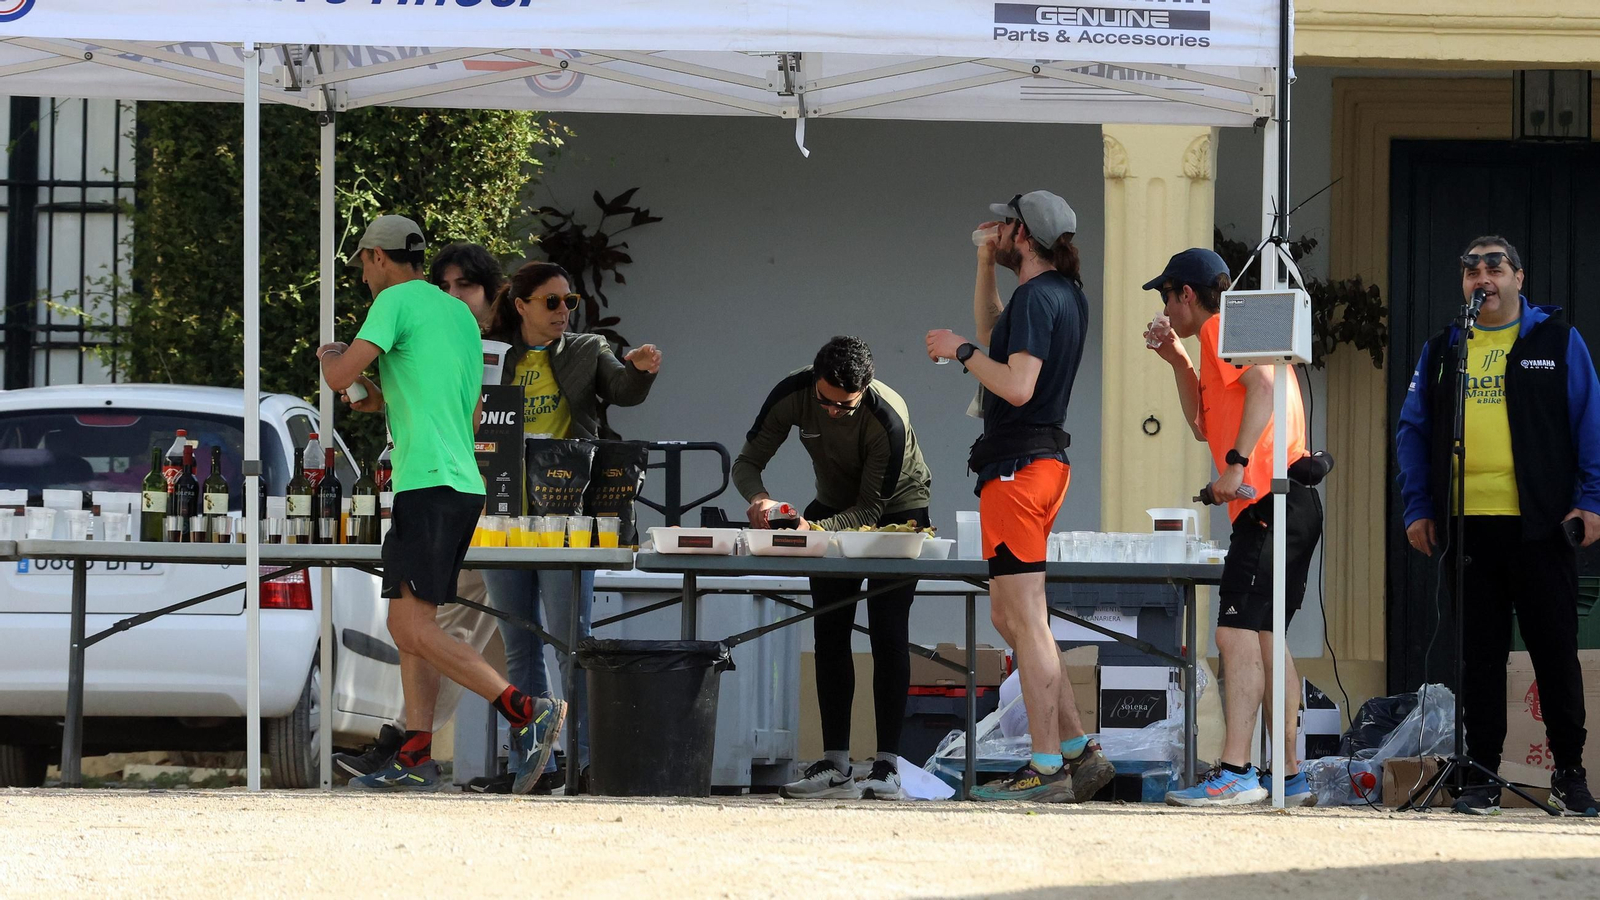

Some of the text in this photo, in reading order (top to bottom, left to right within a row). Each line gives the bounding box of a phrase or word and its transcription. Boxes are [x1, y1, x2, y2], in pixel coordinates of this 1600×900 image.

[1035, 6, 1169, 28] GENUINE
[993, 27, 1210, 48] Parts & Accessories
[1529, 359, 1556, 367] YAMAHA
[546, 469, 573, 479] HSN
